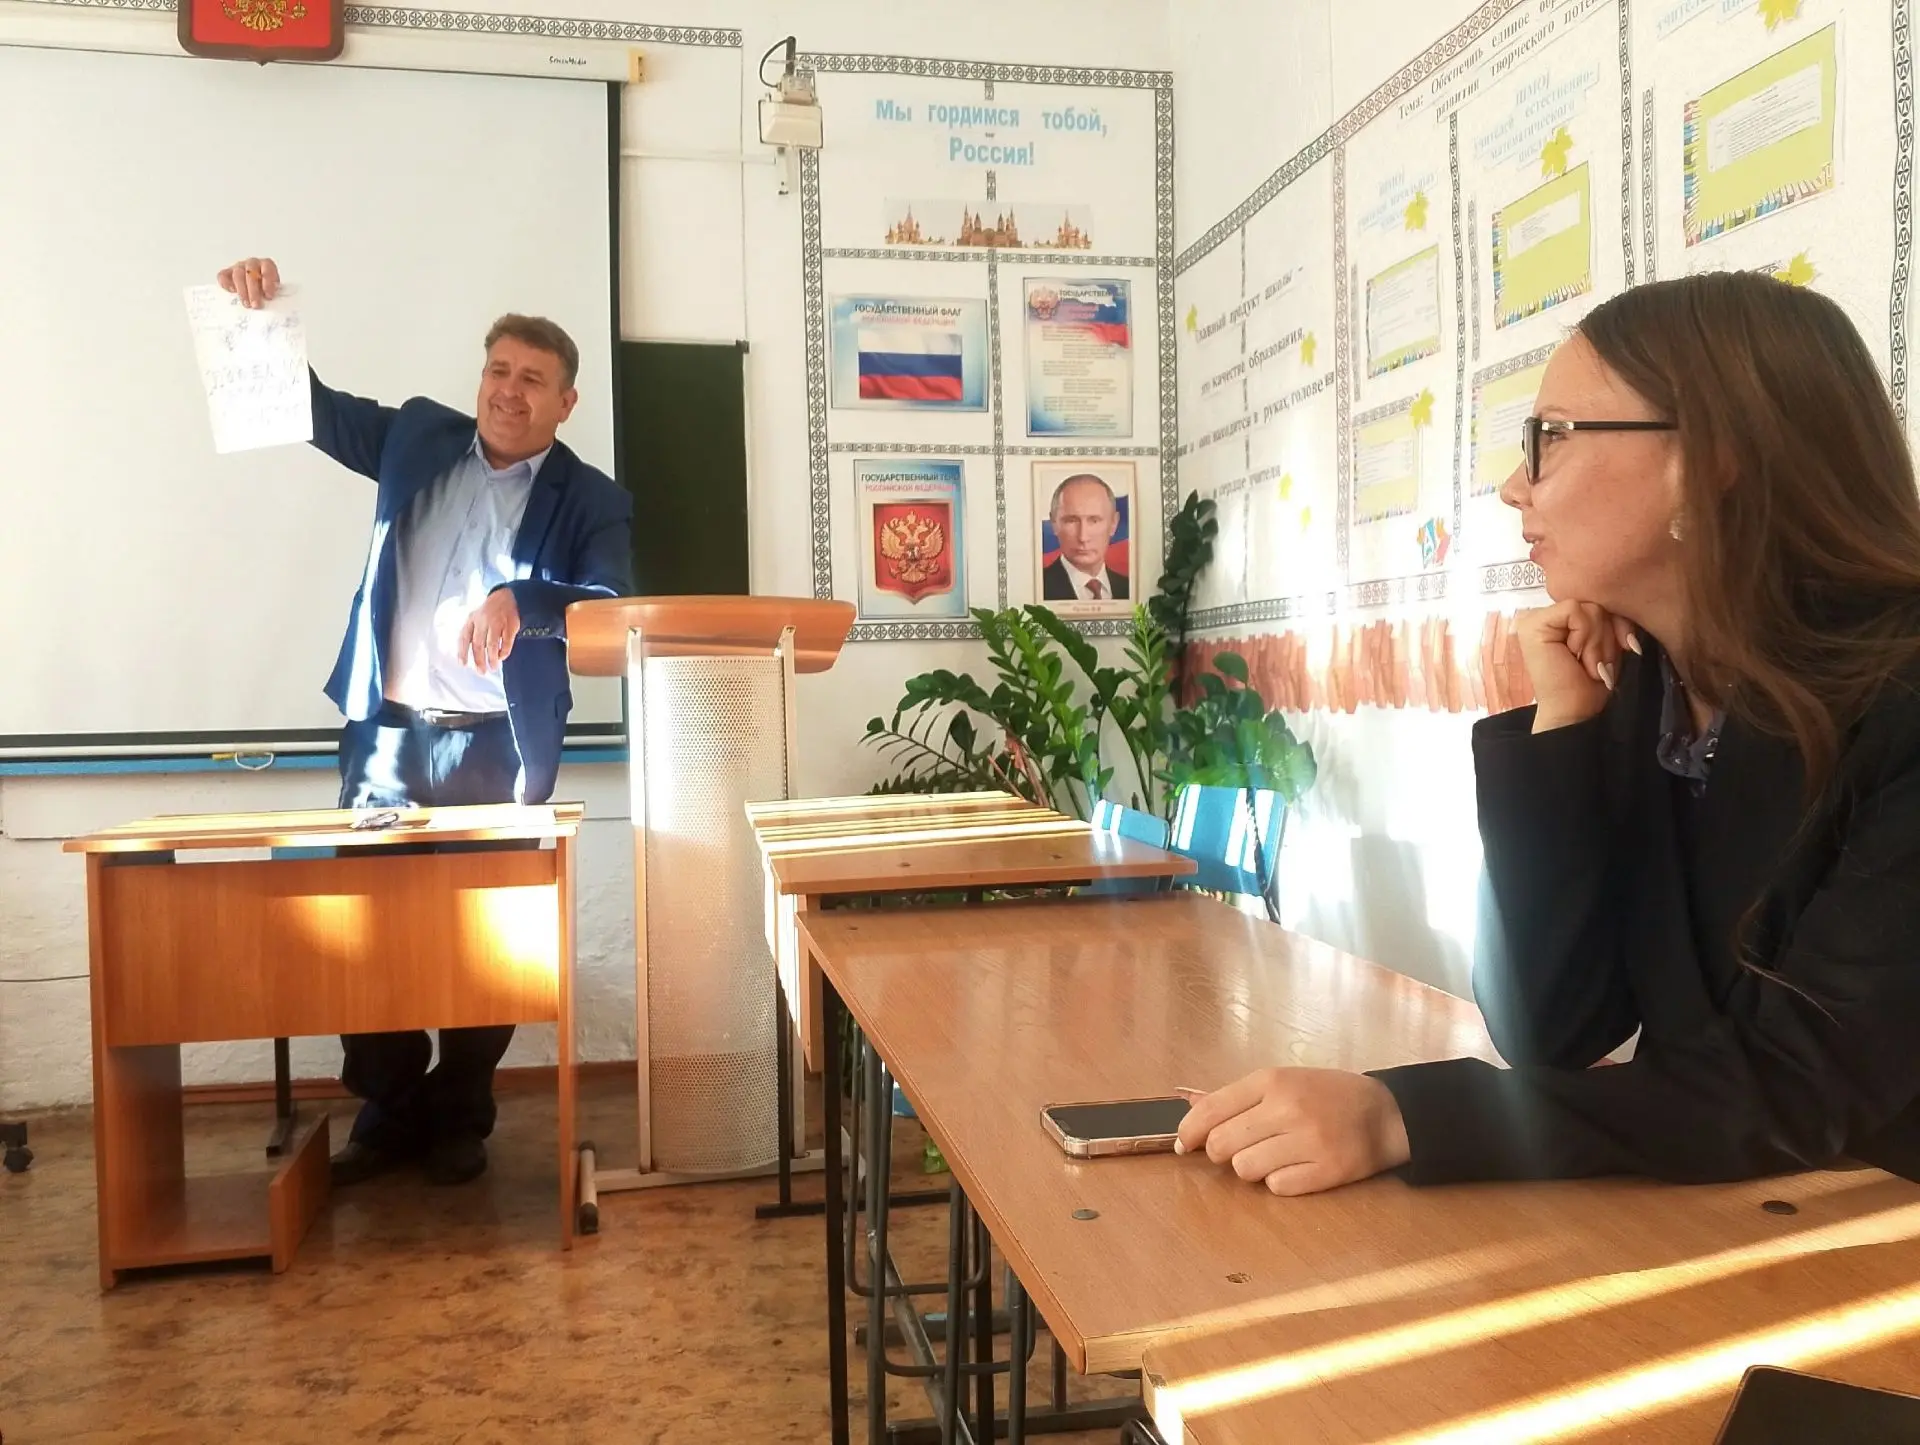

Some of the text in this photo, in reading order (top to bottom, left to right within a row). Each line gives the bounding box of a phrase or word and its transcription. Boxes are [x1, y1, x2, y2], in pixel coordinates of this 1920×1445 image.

[1431, 48, 1484, 94] Обеспечить
[1491, 12, 1530, 47] единое
[1490, 20, 1555, 76] творческого
[876, 99, 1108, 138] Мы гордимся тобой,
[949, 137, 1035, 165] Россия!
[855, 304, 963, 316] ГОСУДАРСТВЕННЫЙ ФЛАГ
[1229, 293, 1260, 324] продукт
[860, 473, 939, 482] ГОСУДАРСТВЕННЫЙ
